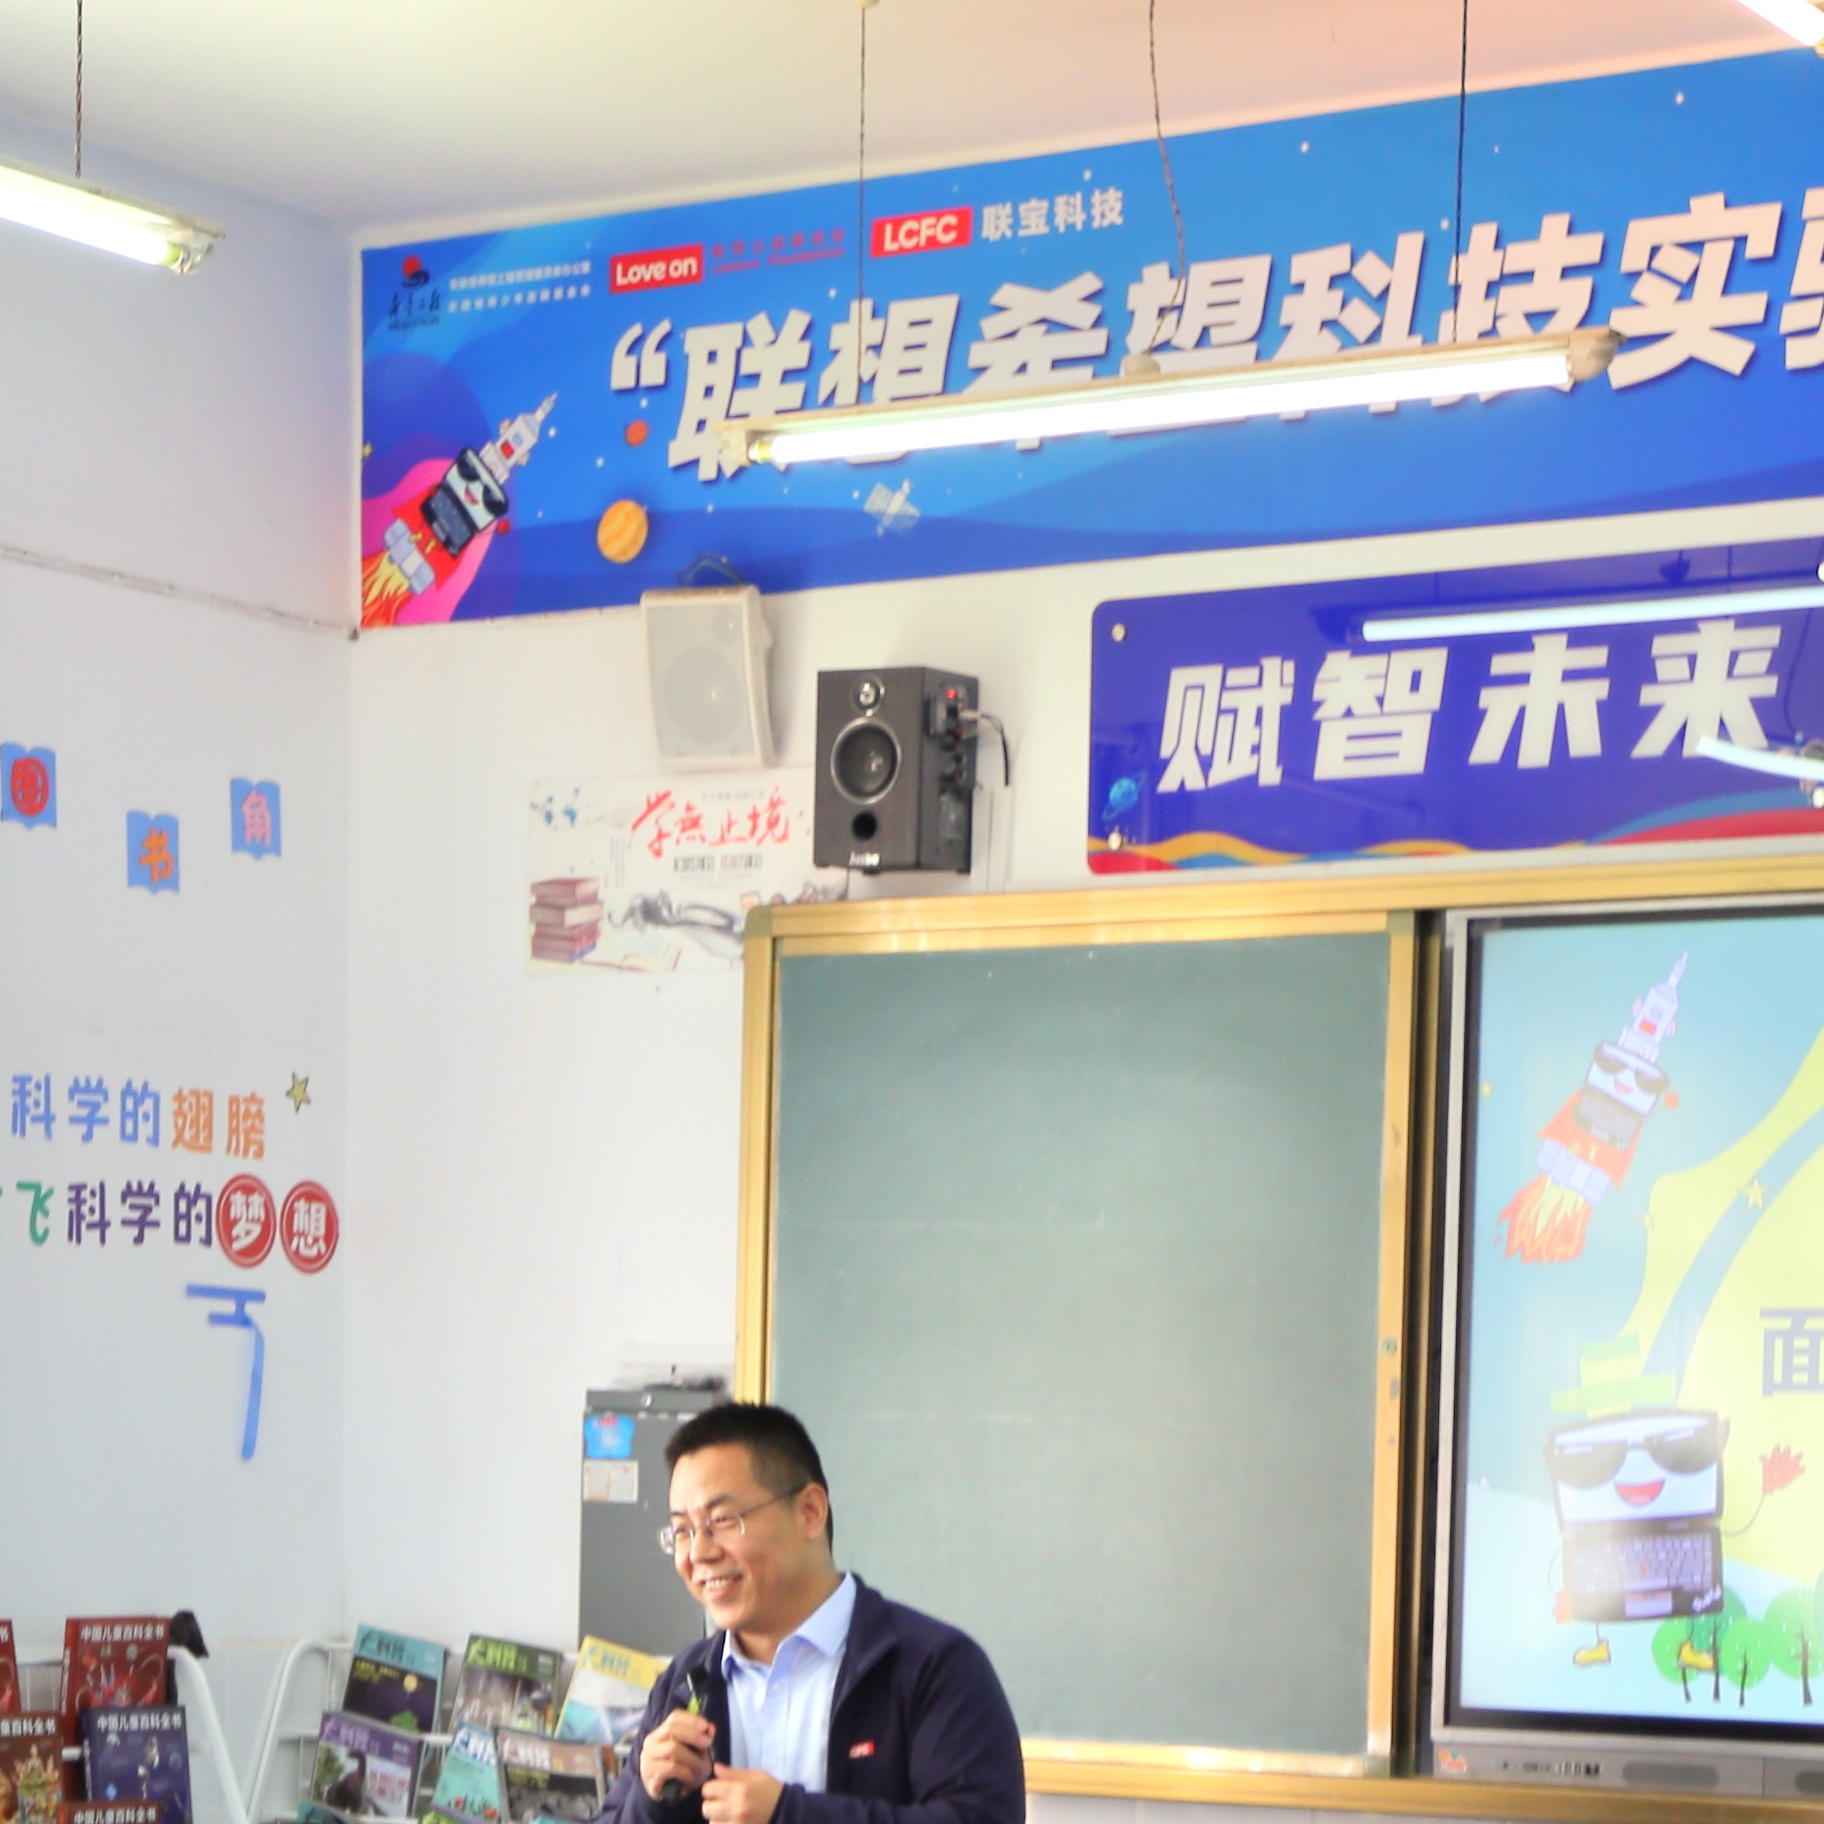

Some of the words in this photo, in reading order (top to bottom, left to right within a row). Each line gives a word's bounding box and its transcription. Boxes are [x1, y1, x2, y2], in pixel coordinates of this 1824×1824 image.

[883, 214, 959, 252] LCFC
[981, 187, 1124, 242] 联宝科技
[616, 254, 666, 286] Love
[669, 255, 698, 279] on
[1157, 619, 1782, 794] 赋智未来
[138, 828, 173, 884] 书
[241, 786, 272, 847] 角
